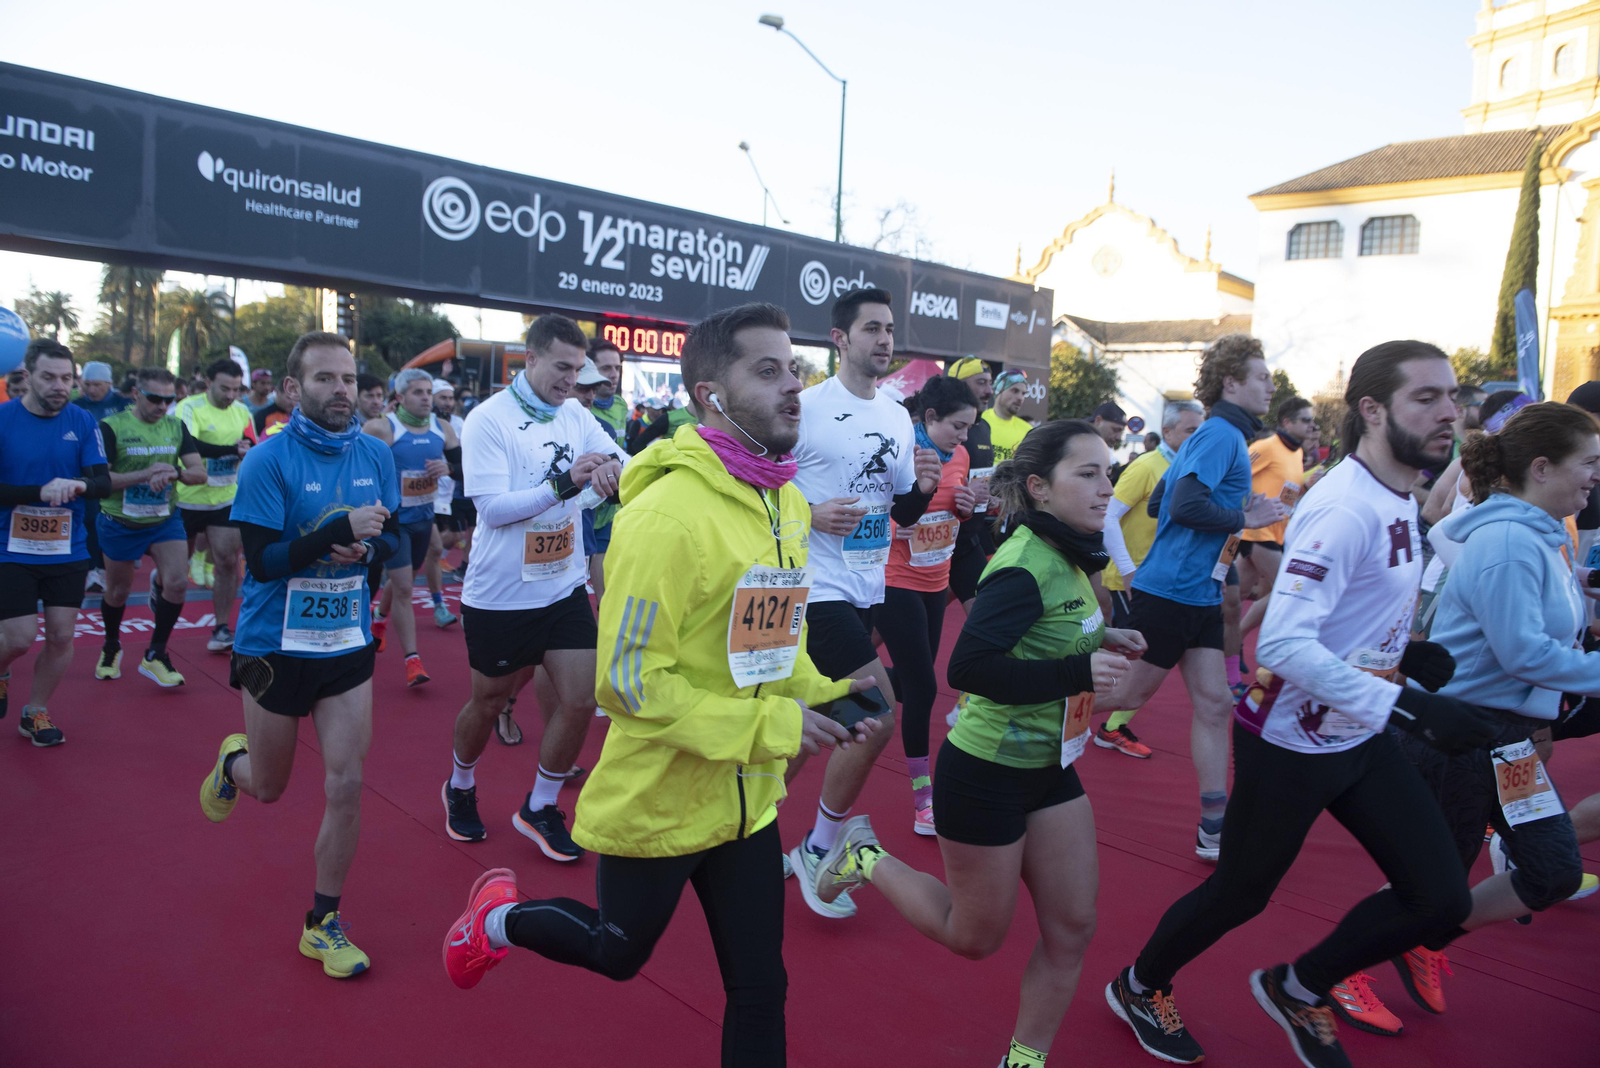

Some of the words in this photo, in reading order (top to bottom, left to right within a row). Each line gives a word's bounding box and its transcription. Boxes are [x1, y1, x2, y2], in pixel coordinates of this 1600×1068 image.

[21, 153, 93, 182] Motor
[222, 168, 361, 207] quirónsalud
[245, 198, 314, 222] Healthcare
[315, 209, 359, 229] Partner
[485, 193, 566, 252] edp
[617, 217, 743, 264] maratón
[650, 252, 746, 291] sevilla
[559, 272, 578, 290] 29
[581, 278, 626, 297] enero
[628, 282, 664, 302] 2023
[909, 291, 959, 321] HOKA
[634, 328, 658, 354] 00
[305, 481, 321, 493] edp
[353, 478, 373, 487] HOKA
[20, 517, 58, 533] 3982
[853, 519, 886, 540] 2560
[917, 524, 950, 543] 4053
[535, 531, 569, 554] 3726
[311, 581, 328, 590] edp
[753, 570, 768, 584] edp
[300, 596, 349, 619] 2538
[742, 595, 790, 631] 4121
[1063, 596, 1086, 613] HOKA
